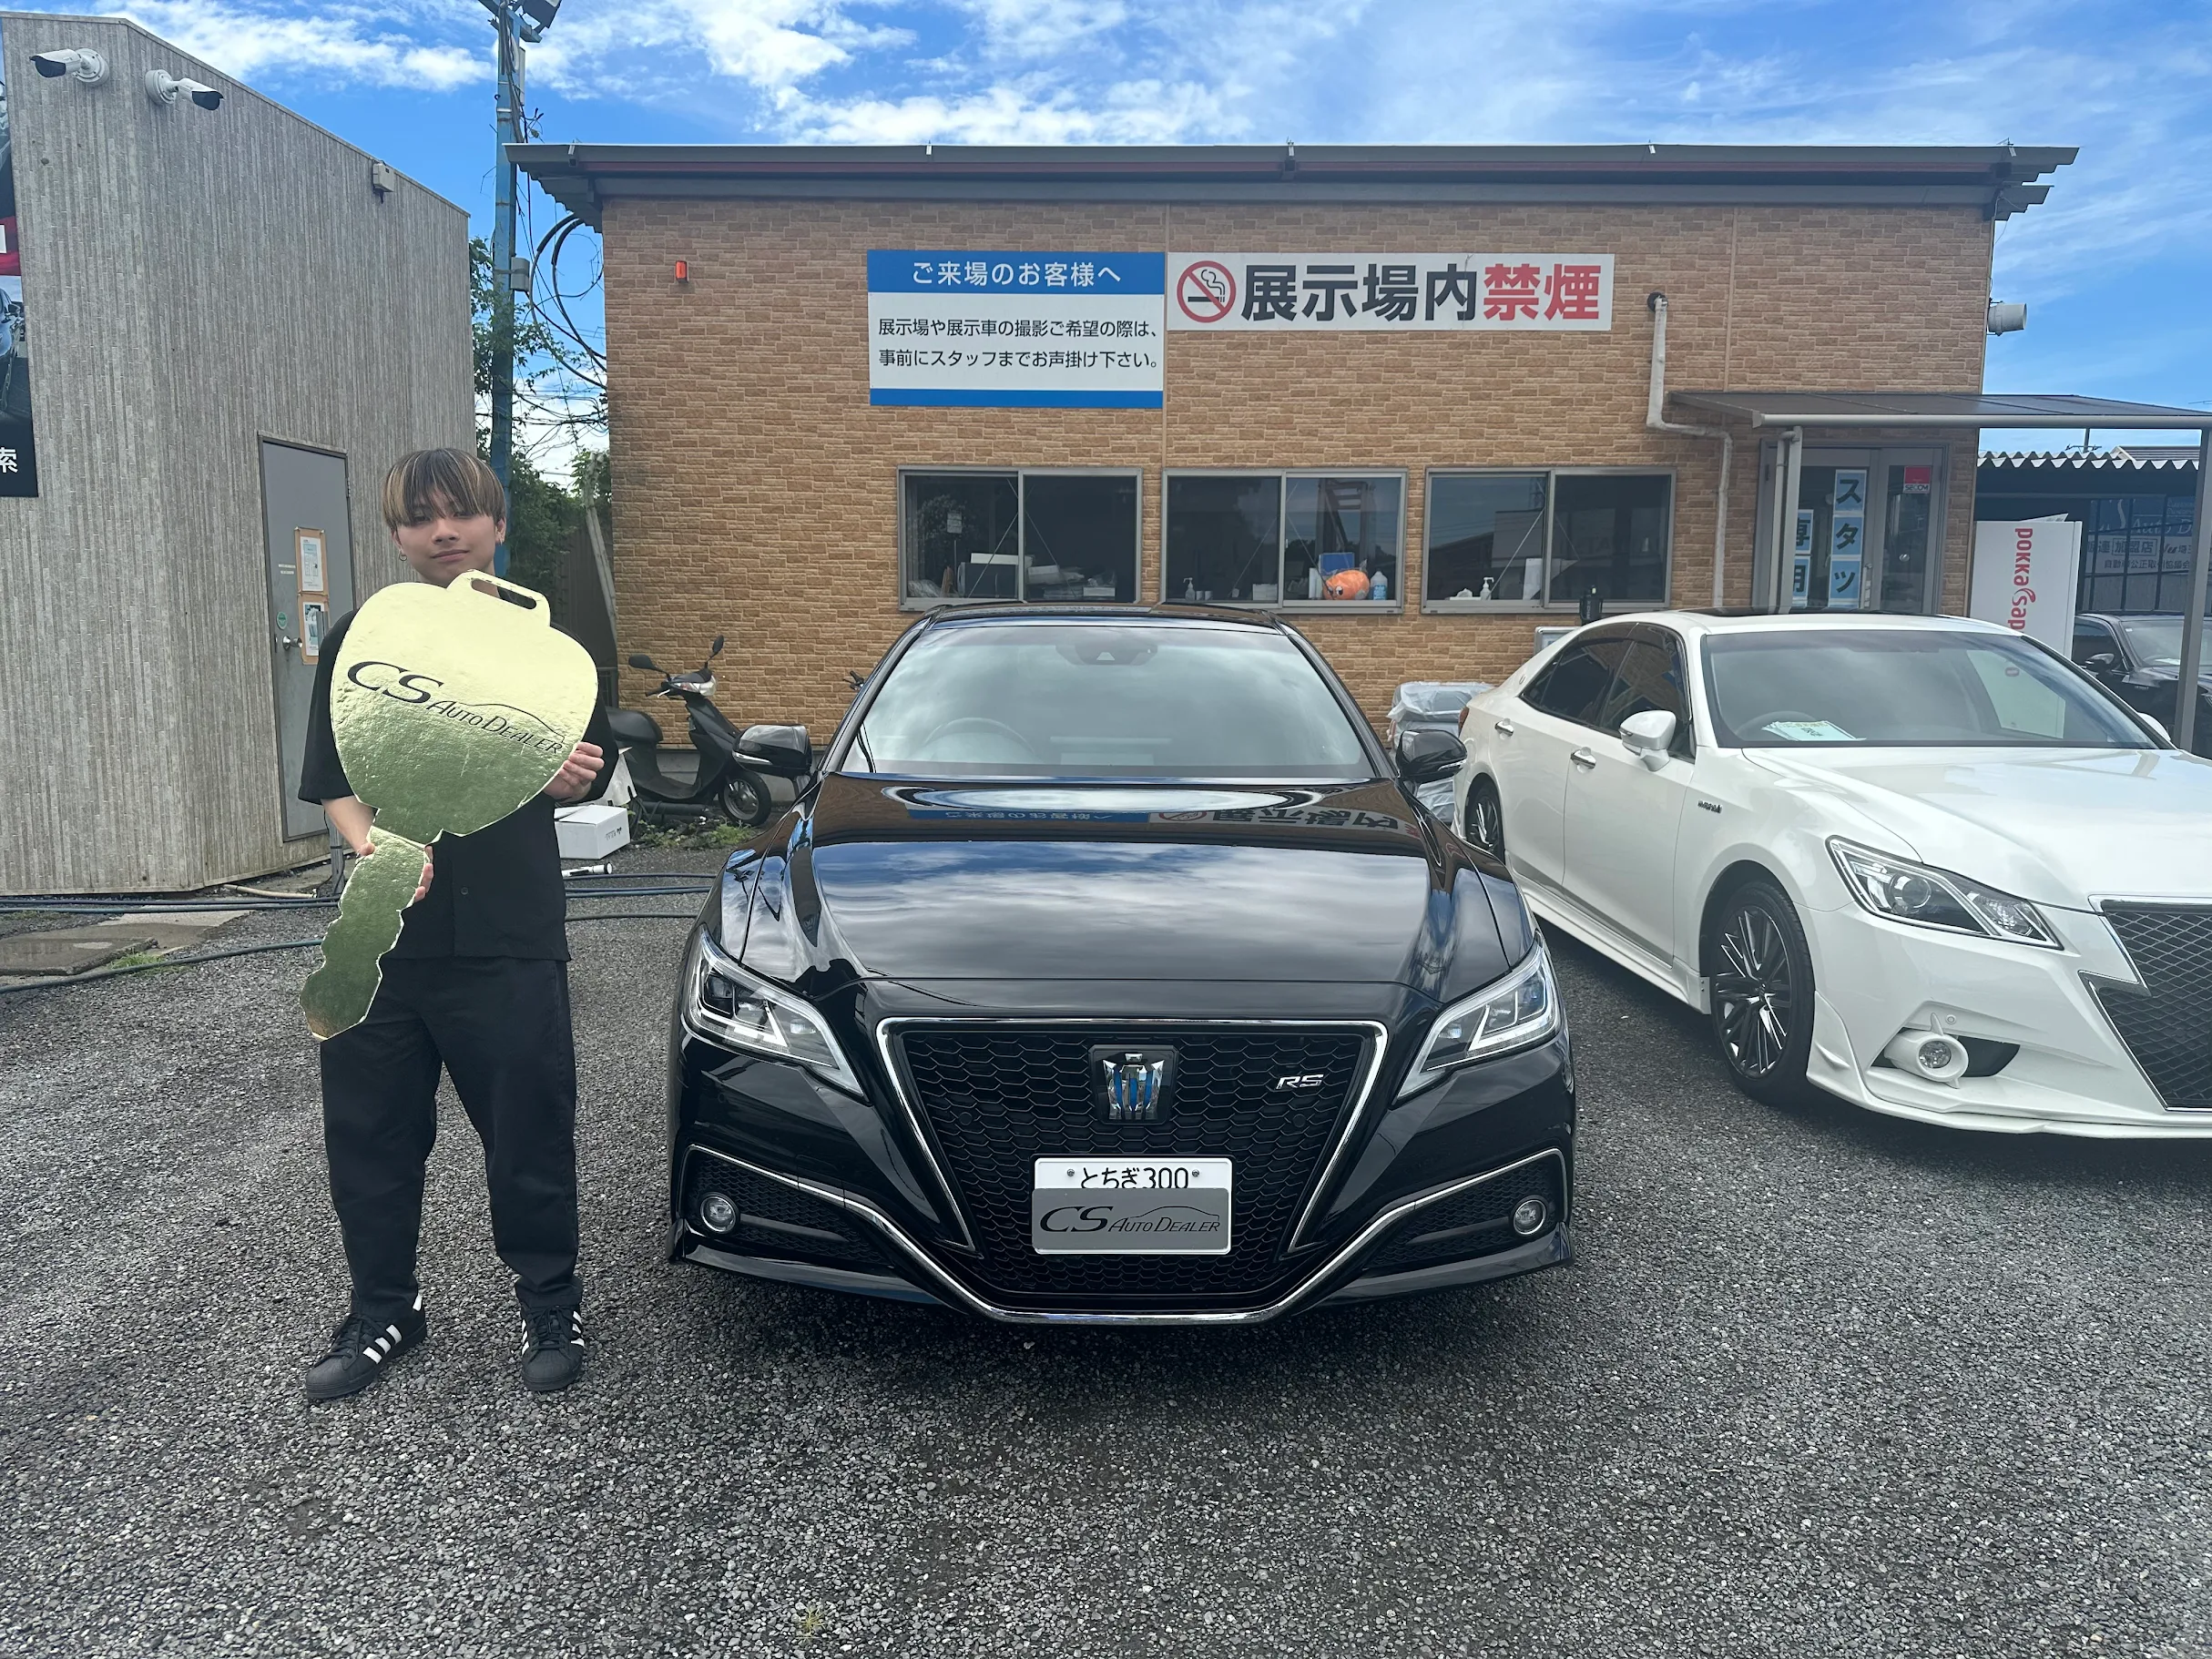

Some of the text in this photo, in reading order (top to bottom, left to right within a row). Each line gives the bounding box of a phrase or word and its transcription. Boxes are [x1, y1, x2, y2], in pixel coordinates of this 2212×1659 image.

[912, 260, 1121, 288] ご来場のお客様へ
[1240, 262, 1602, 322] 展示場内禁煙
[878, 318, 1158, 339] 展示場や展示車の撮影ご希望の際は、
[878, 349, 1158, 370] 事前にスタッフまでお声掛け下さい。
[347, 661, 444, 704] CS
[1275, 1074, 1324, 1090] RS
[1039, 1206, 1114, 1232] CS
